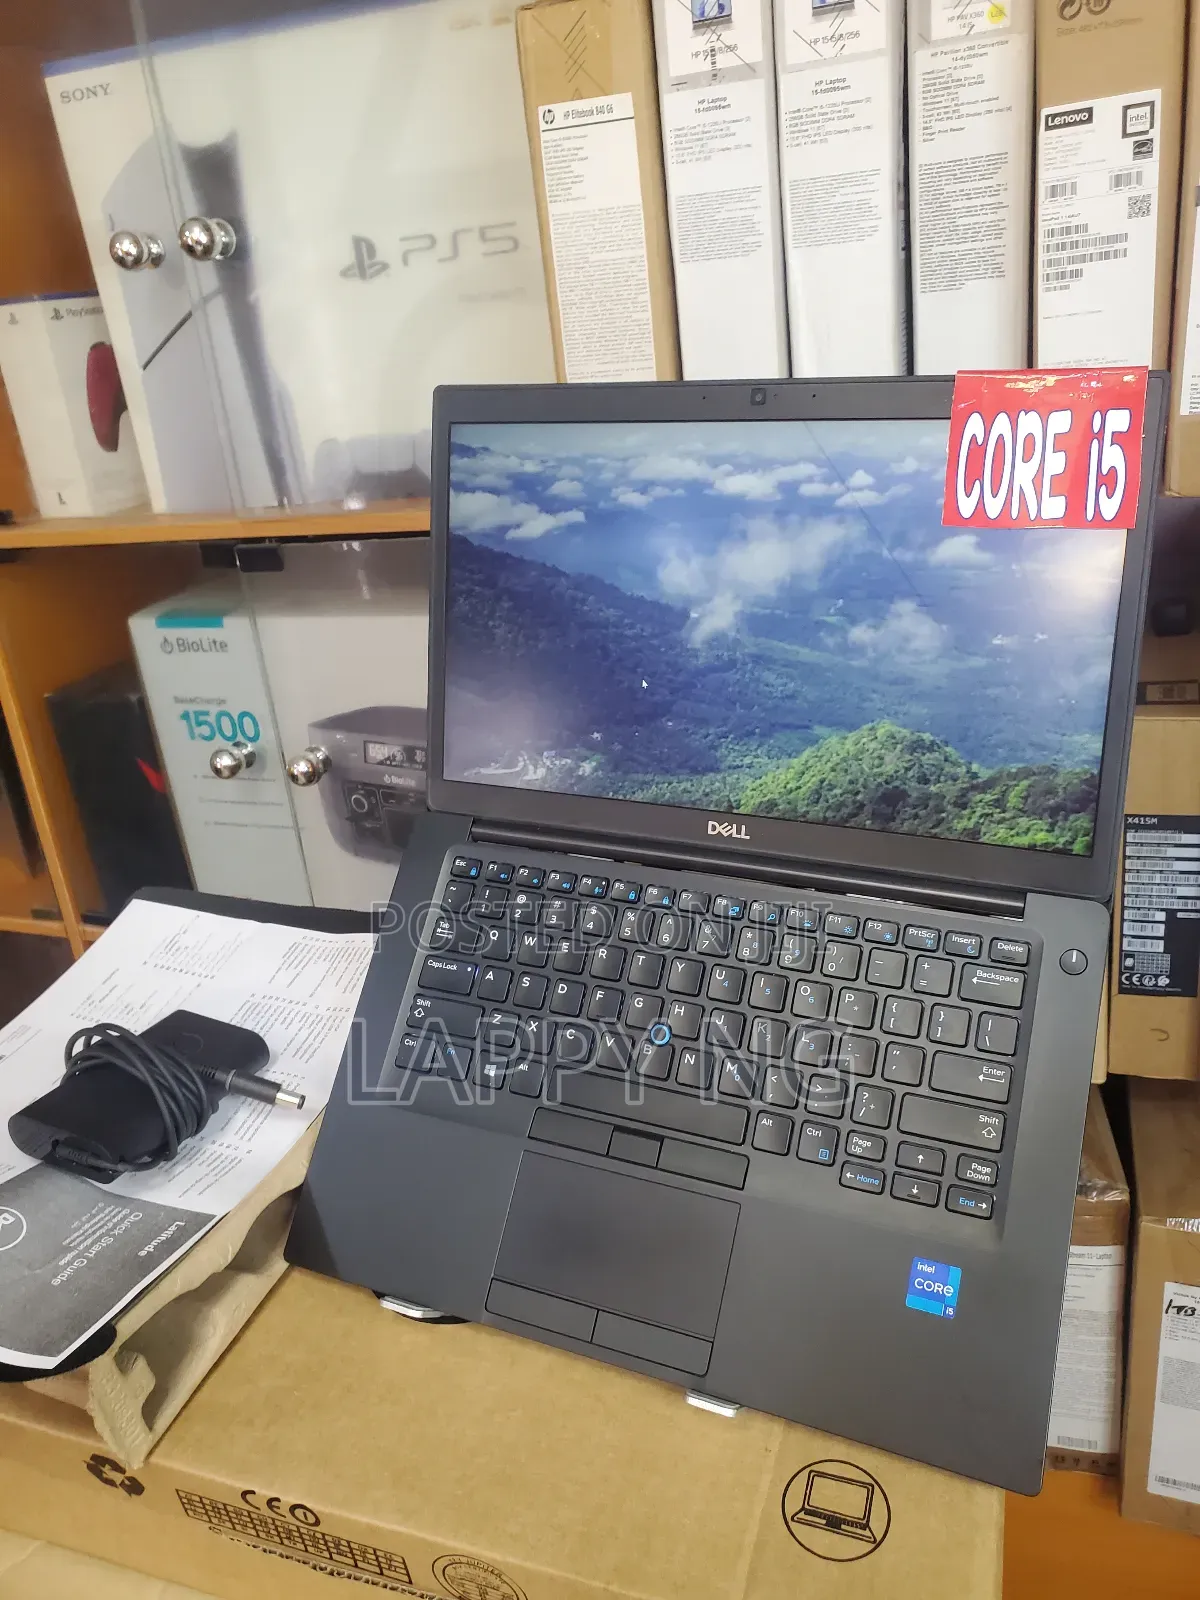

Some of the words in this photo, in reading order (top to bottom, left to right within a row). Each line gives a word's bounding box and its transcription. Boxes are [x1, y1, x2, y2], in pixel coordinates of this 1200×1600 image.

[825, 77, 847, 85] Laptop
[60, 83, 112, 104] SONY
[563, 112, 570, 120] HP
[571, 108, 595, 119] Elitebook
[1048, 113, 1088, 126] Lenovo
[399, 221, 520, 267] PS5
[956, 409, 1072, 520] CORE
[1086, 408, 1132, 522] i5
[176, 637, 228, 654] BioLite
[180, 710, 260, 743] 1500
[1127, 817, 1158, 825] X415M
[708, 820, 750, 840] DELL
[515, 909, 521, 918] 2
[550, 915, 557, 924] 3
[828, 916, 841, 924] F11
[587, 921, 593, 929] 4
[868, 922, 882, 931] F12
[490, 930, 499, 940] Q
[624, 928, 631, 936] 5
[909, 929, 935, 939] PrtScr
[524, 936, 537, 946] W
[662, 934, 670, 942] 6
[952, 935, 976, 945] Insert
[562, 942, 570, 952] E
[702, 941, 709, 949] 7
[998, 943, 1024, 952] Delete
[598, 949, 607, 959] R
[742, 948, 750, 956] 8
[637, 955, 646, 966] T
[784, 955, 792, 963] 9
[427, 960, 442, 969] Caps
[443, 963, 458, 971] Lock
[676, 962, 685, 972] Y
[828, 963, 836, 971] 0
[485, 971, 494, 981] A
[716, 969, 726, 980] U
[976, 970, 1019, 983] Backspace
[522, 977, 531, 987] S
[558, 984, 567, 994] D
[800, 985, 810, 996] O
[596, 991, 605, 1001] F
[845, 994, 855, 1003] P
[416, 999, 432, 1007] Shift
[634, 998, 644, 1007] G
[675, 1005, 685, 1016] H
[492, 1014, 502, 1025] Z
[716, 1015, 725, 1025] J
[528, 1021, 539, 1032] X
[757, 1023, 767, 1034] K
[566, 1029, 576, 1039] C
[801, 1031, 810, 1043] L
[405, 1039, 417, 1047] Ctrl
[606, 1036, 615, 1047] V
[643, 1044, 652, 1055] B
[685, 1054, 695, 1065] N
[518, 1063, 529, 1071] Alt
[726, 1062, 737, 1074] M
[983, 1066, 1006, 1076] Enter
[761, 1118, 773, 1127] Alt
[979, 1114, 1000, 1125] Shift
[806, 1128, 822, 1138] Ctrl
[853, 1137, 872, 1148] Page
[851, 1144, 863, 1153] Up
[971, 1163, 992, 1174] Page
[856, 1174, 879, 1185] Home
[967, 1170, 991, 1182] Down
[959, 1197, 975, 1207] End
[110, 1212, 143, 1236] Quick
[138, 1221, 186, 1257] Latitude
[86, 1236, 114, 1258] Start
[51, 1258, 88, 1286] Guide
